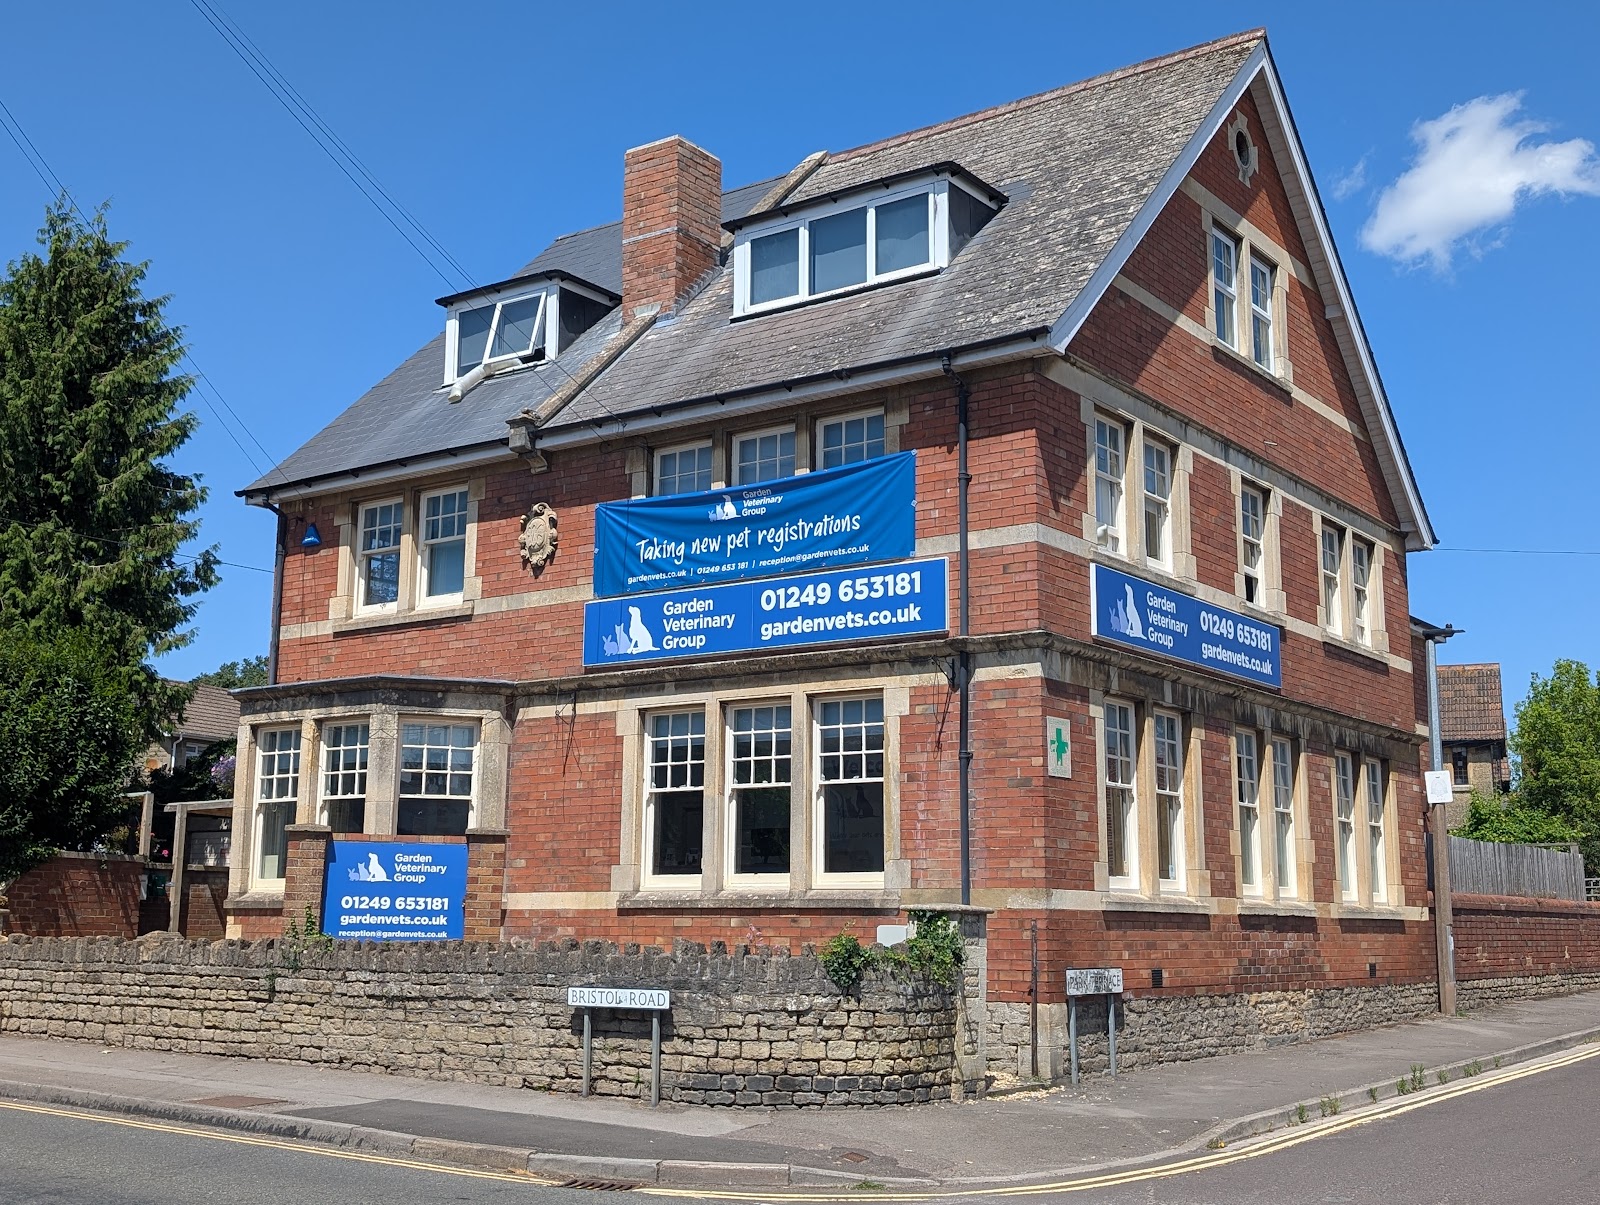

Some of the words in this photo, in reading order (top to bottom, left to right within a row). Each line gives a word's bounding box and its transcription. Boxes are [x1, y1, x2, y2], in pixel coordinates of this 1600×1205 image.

[742, 487, 772, 500] Garden
[743, 494, 784, 508] Veterinary
[741, 505, 767, 517] Group
[636, 539, 686, 565] Taking
[691, 537, 721, 556] new
[726, 528, 751, 557] pet
[758, 512, 861, 552] registrations
[627, 568, 687, 585] gardenvets.co.uk
[697, 564, 720, 575] 01249
[721, 562, 736, 572] 653
[737, 561, 749, 570] 181
[759, 543, 870, 567] reception@gardenvets.co.uk
[760, 585, 832, 612] 01249
[838, 570, 921, 600] 653181
[662, 597, 714, 616] Garden
[1146, 591, 1176, 614] Garden
[662, 613, 736, 634] Veterinary
[760, 603, 922, 641] gardenvets.co.uk
[1147, 608, 1189, 637] Veterinary
[1148, 626, 1174, 650] Group
[1199, 611, 1234, 641] 01249
[1236, 622, 1272, 653] 653181
[662, 633, 706, 651] Group
[1201, 641, 1273, 676] gardenvets.co.uk
[394, 853, 433, 863] Garden
[394, 863, 447, 875] Veterinary
[393, 873, 426, 884] Group
[341, 895, 391, 910] 01249
[394, 897, 449, 911] 653181
[340, 913, 448, 926] gardenvets.co.uk
[338, 930, 448, 939] reception@gardenvets.co.uk
[571, 989, 621, 1005] BRISTOL
[629, 991, 666, 1007] ROAD
